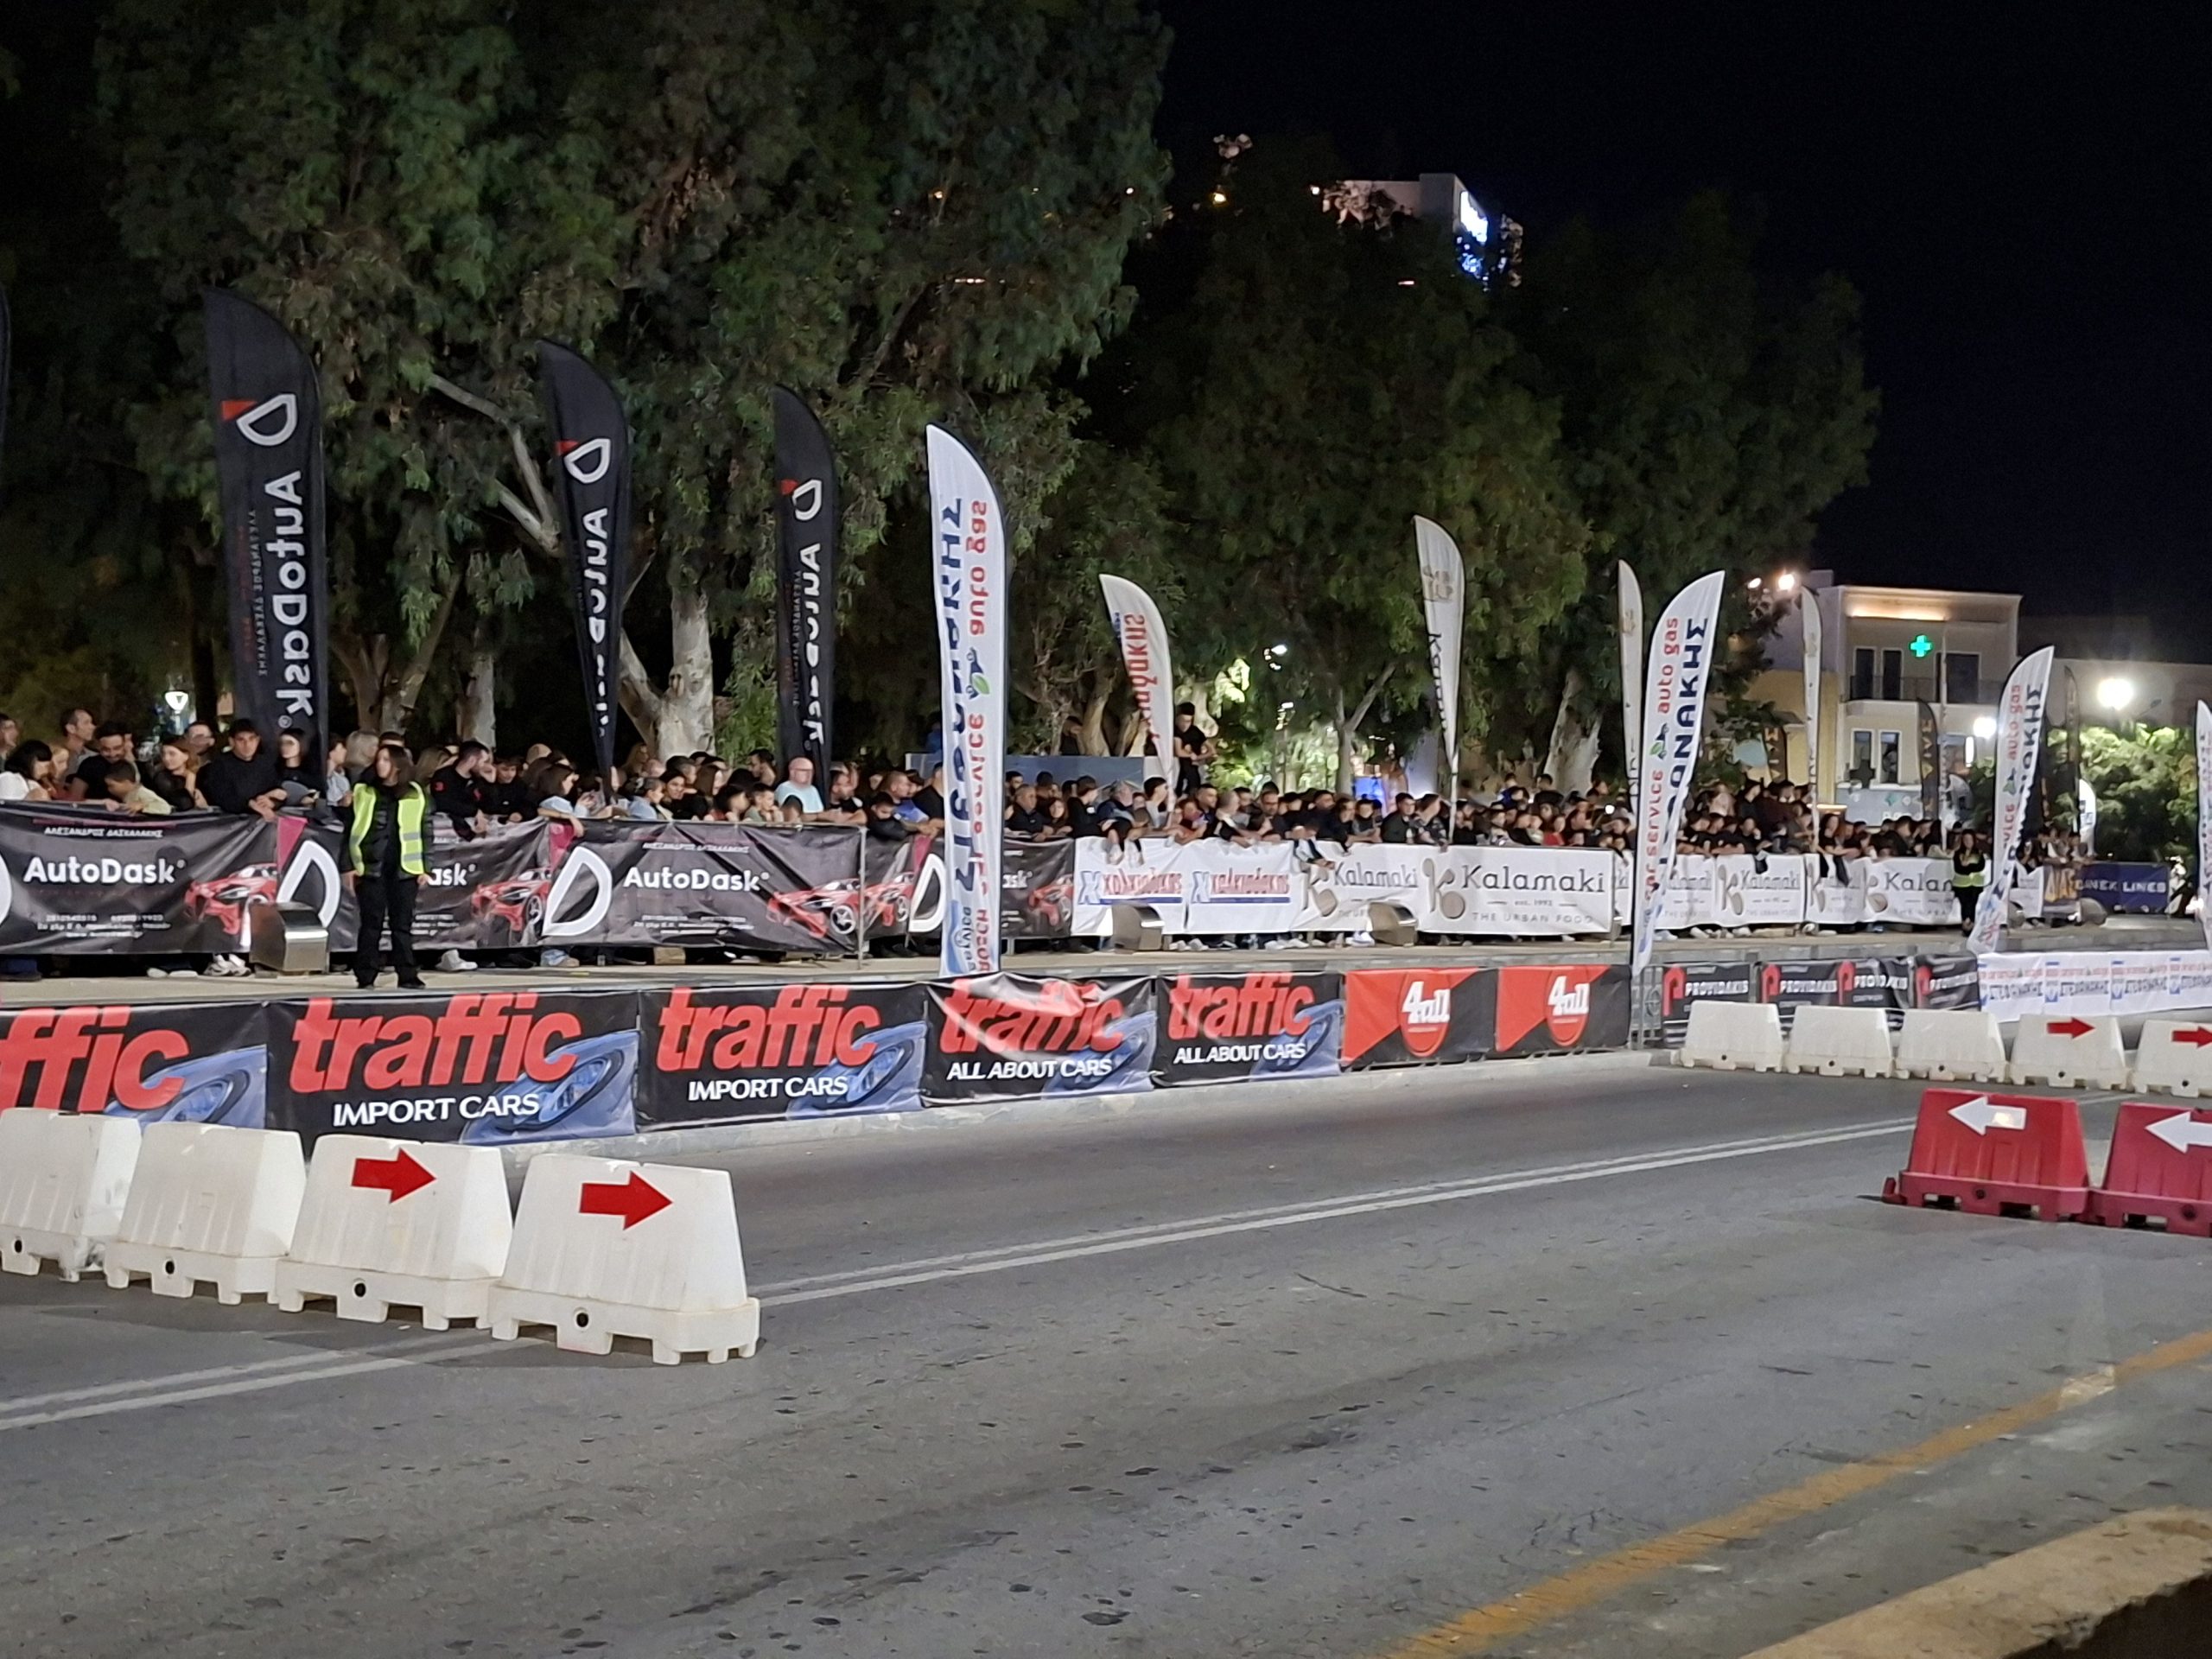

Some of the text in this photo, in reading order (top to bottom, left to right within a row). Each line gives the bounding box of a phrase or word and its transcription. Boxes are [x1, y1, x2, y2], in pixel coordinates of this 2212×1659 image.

[1663, 617, 1681, 655] gas
[1655, 665, 1675, 715] auto
[2008, 684, 2023, 714] gas
[2005, 721, 2018, 760] auto
[1645, 769, 1664, 856] service
[1335, 861, 1419, 888] Kalamaki
[1461, 865, 1605, 893] Kalamaki
[1472, 912, 1497, 922] THE
[1504, 912, 1549, 922] URBAN
[939, 978, 1123, 1052] traffic
[1168, 969, 1314, 1039] traffic
[289, 991, 582, 1093] traffic
[656, 984, 880, 1072] traffic
[0, 1005, 189, 1113] ffic
[947, 1058, 1112, 1082] ALL ABOUT CARS
[1173, 1042, 1306, 1065] ALL ABOUT CARS
[688, 1076, 849, 1102] IMPORT CARS
[333, 1093, 539, 1127] IMPORT CARS
